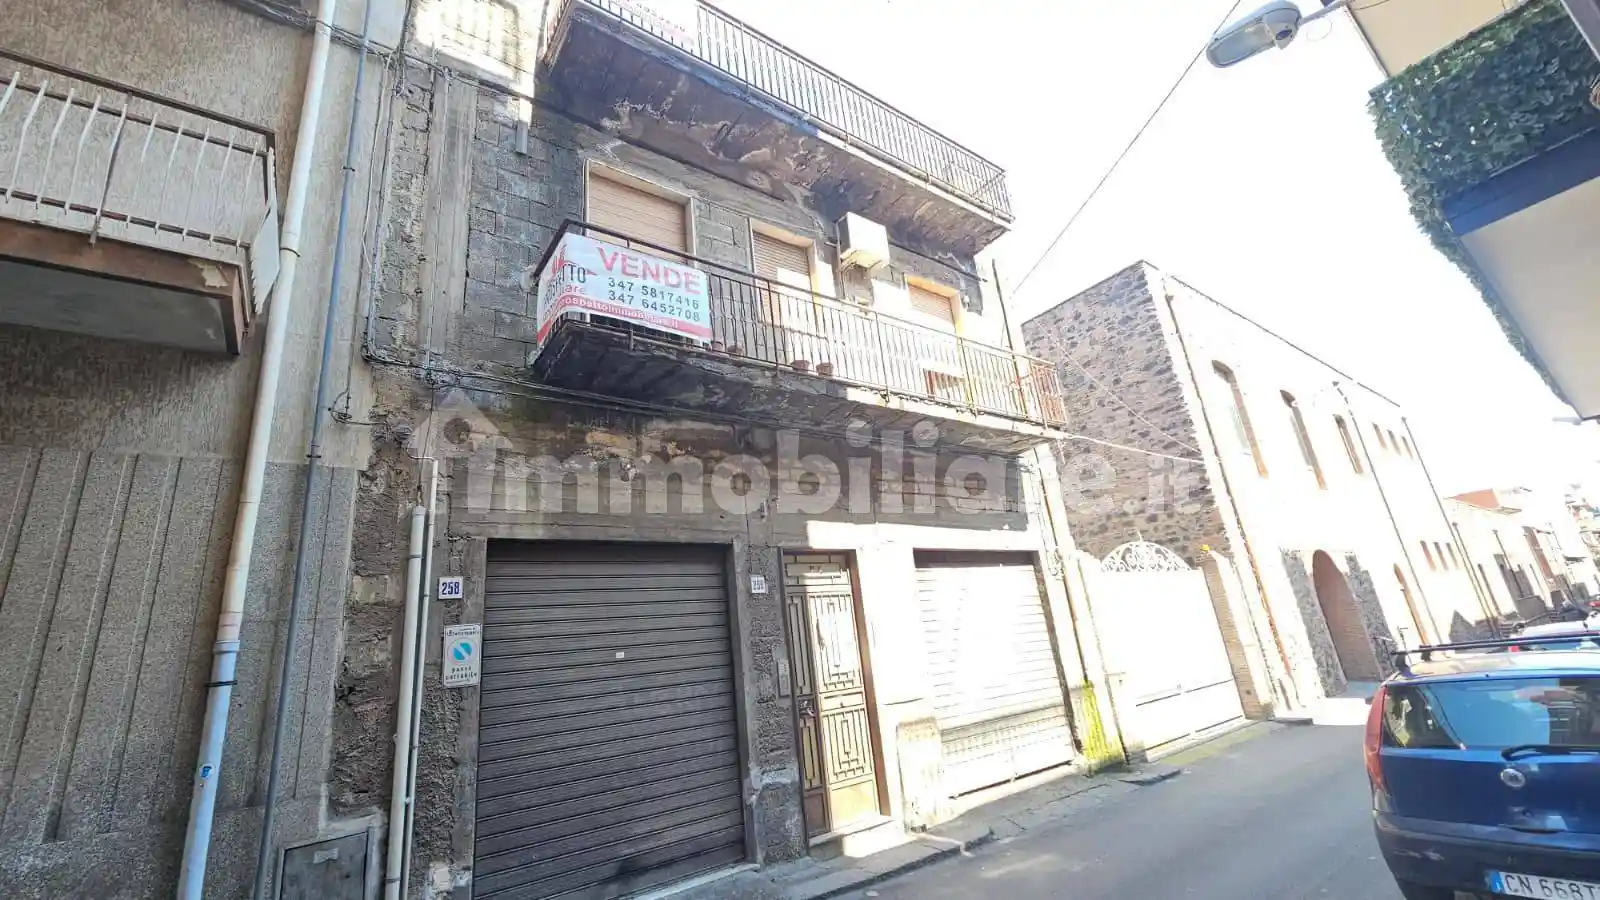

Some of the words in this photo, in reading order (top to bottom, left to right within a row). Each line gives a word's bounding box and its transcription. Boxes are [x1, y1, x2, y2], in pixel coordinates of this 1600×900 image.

[596, 246, 703, 295] VENDE
[608, 277, 634, 291] 347
[641, 285, 699, 310] 5817416
[608, 290, 634, 305] 347
[641, 298, 700, 322] 6452708
[441, 581, 460, 595] 258
[1504, 874, 1533, 894] CN
